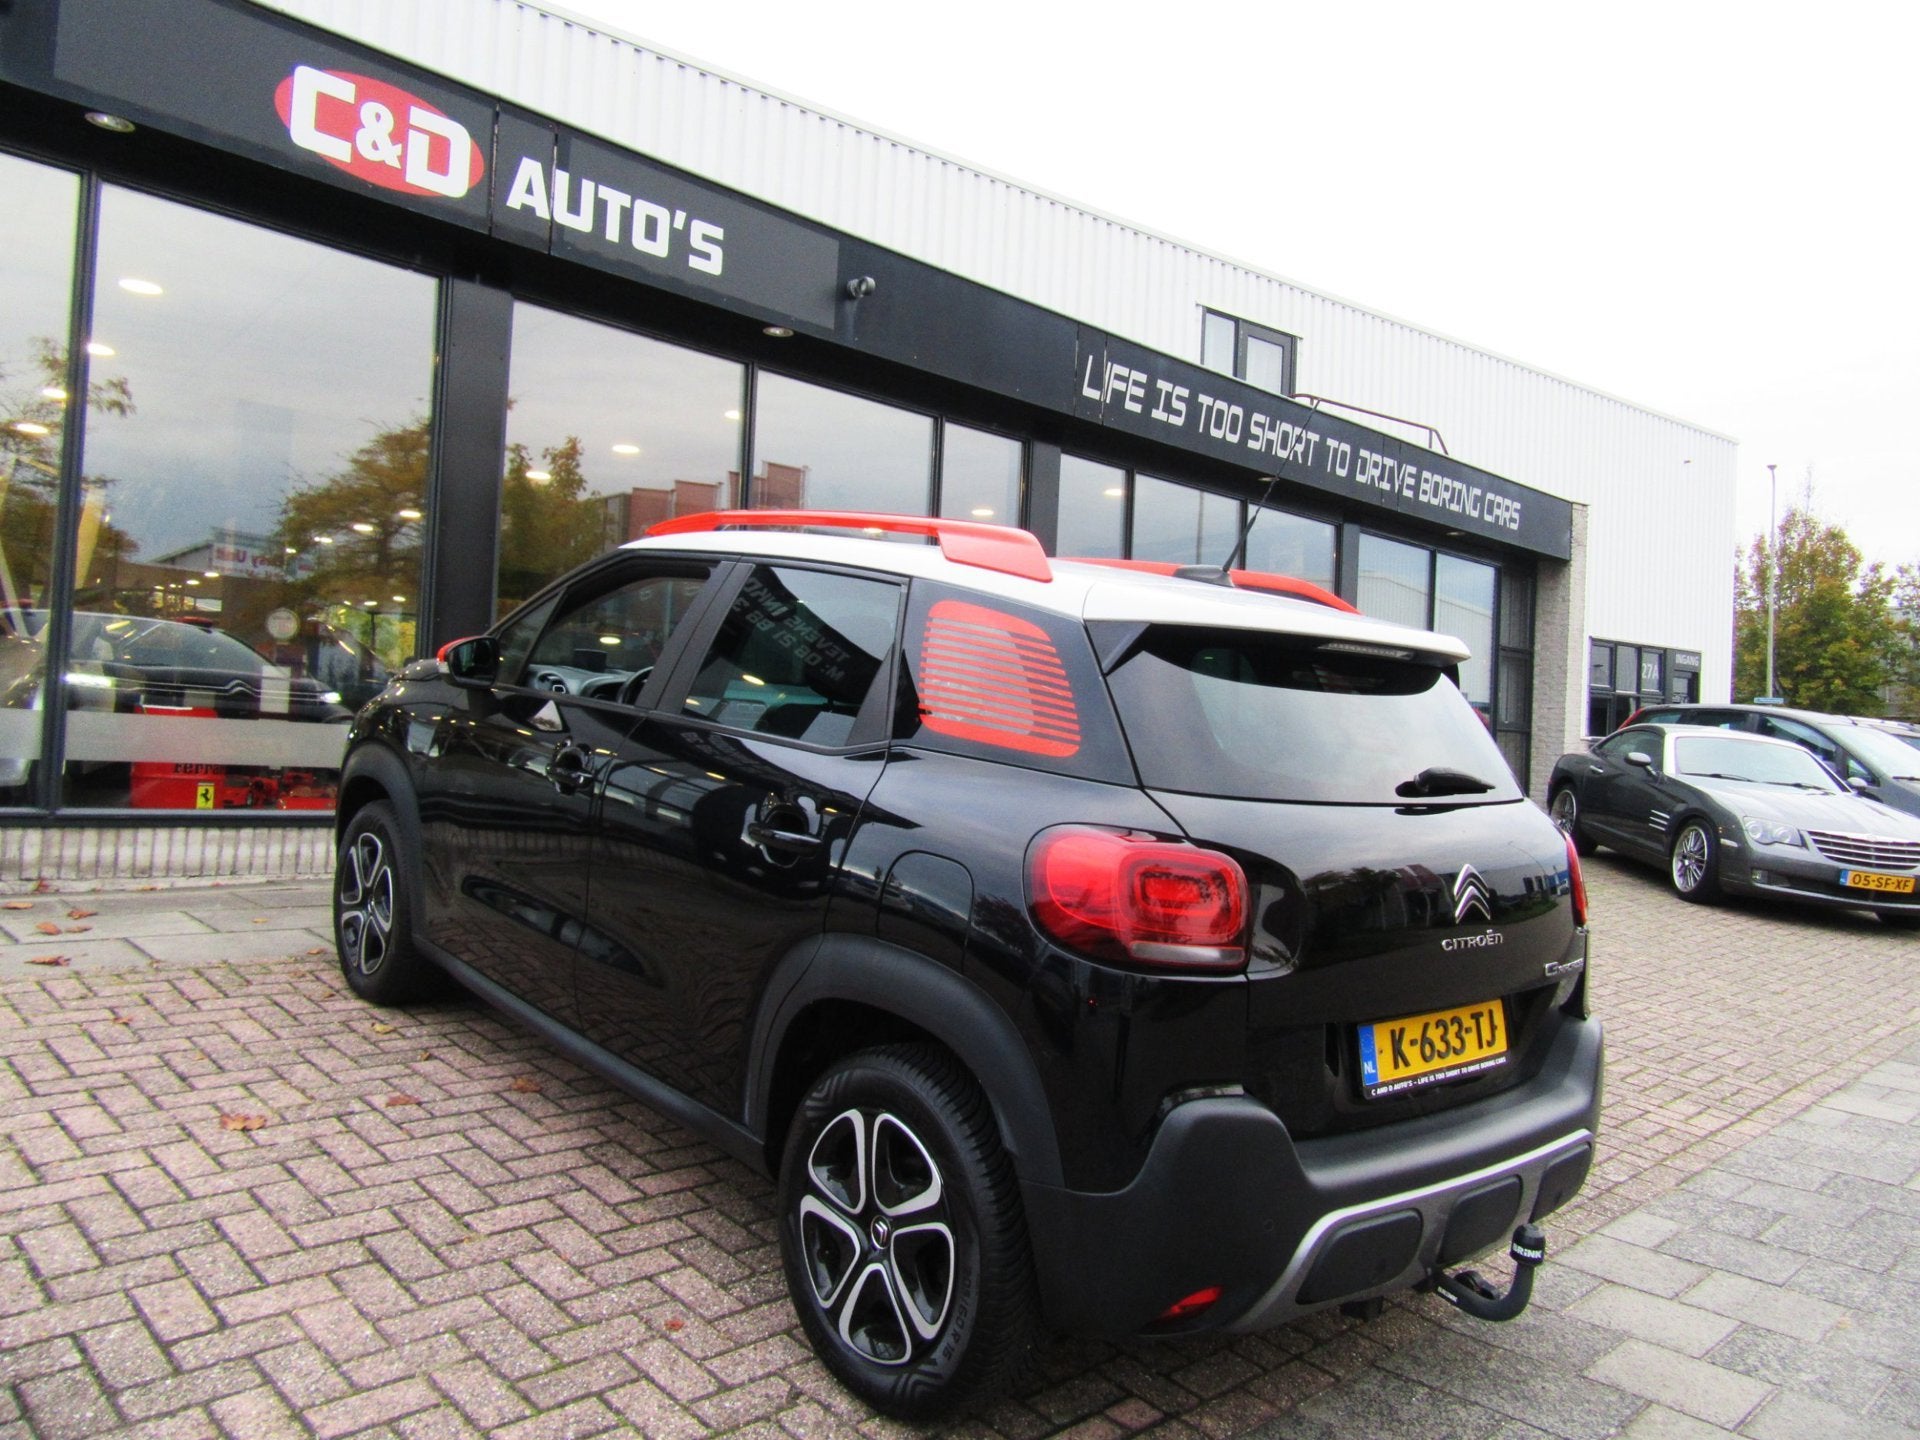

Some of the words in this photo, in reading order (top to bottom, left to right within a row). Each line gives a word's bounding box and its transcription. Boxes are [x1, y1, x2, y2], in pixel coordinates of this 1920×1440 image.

[289, 65, 471, 198] C&D
[506, 156, 724, 276] AUTO'S
[1082, 354, 1148, 414] LIFE
[1151, 378, 1190, 427] IS
[1198, 393, 1244, 444] TOO
[1247, 412, 1320, 467] SHORT
[1326, 437, 1351, 478] TO
[1355, 448, 1417, 498] DRIVE
[1418, 470, 1482, 518] BORING
[1483, 492, 1522, 531] CARS
[1675, 653, 1700, 667] INGANG
[1641, 662, 1659, 680] 27A
[1852, 873, 1911, 890] 05-SF-XF
[1390, 1009, 1497, 1070] K-633-TJ
[1363, 1061, 1376, 1074] NL
[1418, 1076, 1429, 1085] LIFE
